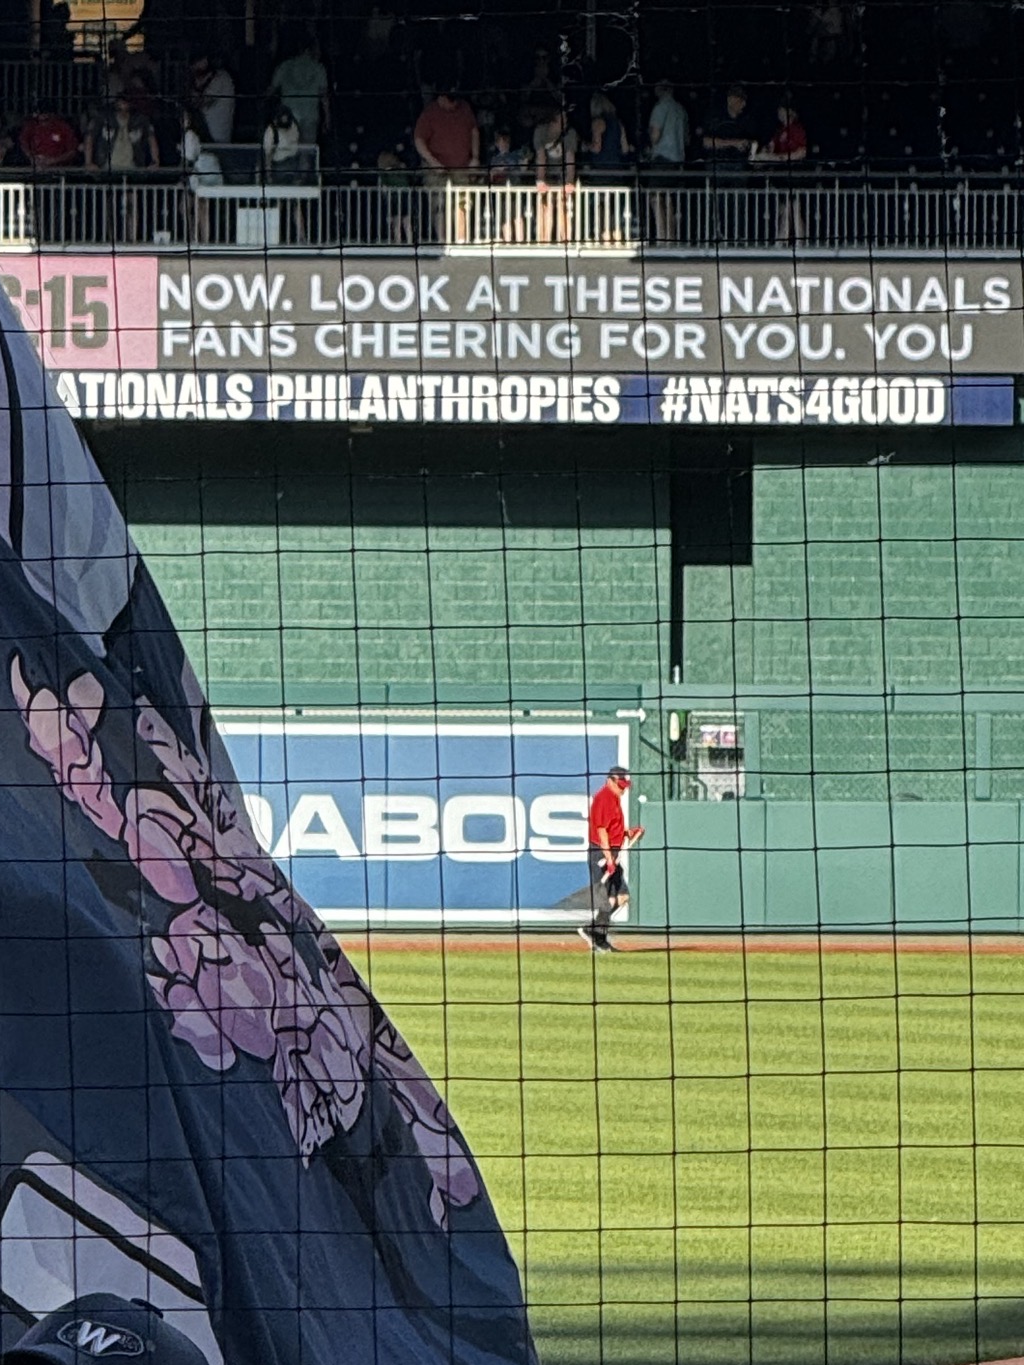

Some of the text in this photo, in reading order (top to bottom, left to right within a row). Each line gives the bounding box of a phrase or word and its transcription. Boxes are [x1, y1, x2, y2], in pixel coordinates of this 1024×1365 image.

[159, 273, 1011, 315] NOW. LOOK AT THESE NATIONALS
[163, 320, 974, 361] FANS CHEERING FOR YOU. YOU
[50, 371, 946, 424] ATIONALS PHILANTHROPIES #NATS4GOOD
